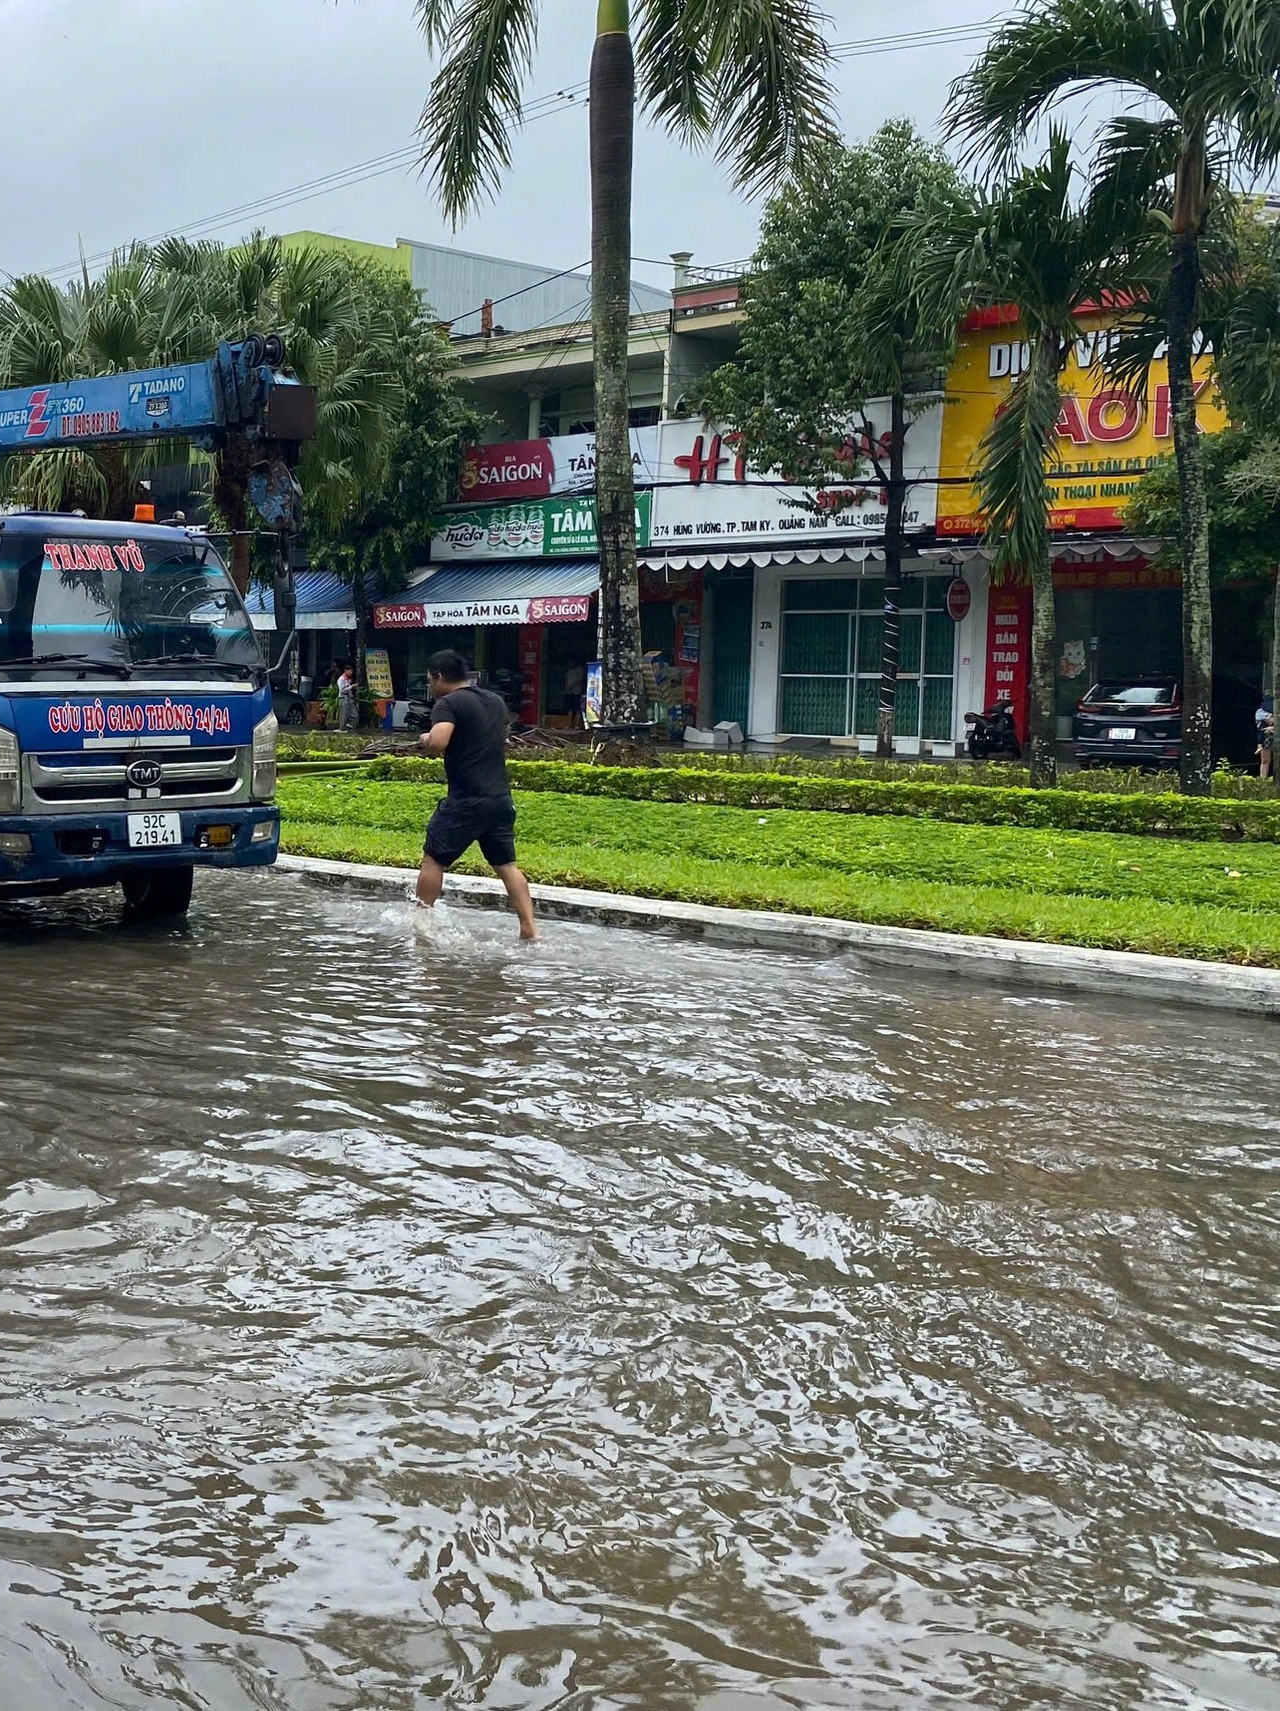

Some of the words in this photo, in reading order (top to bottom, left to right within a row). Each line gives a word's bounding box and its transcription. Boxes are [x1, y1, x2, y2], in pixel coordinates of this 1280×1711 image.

[143, 377, 185, 395] TADANO
[479, 461, 543, 484] SAIGON
[550, 508, 594, 533] TÂM
[653, 525, 669, 536] 374
[43, 543, 118, 571] THANH
[113, 539, 145, 572] VŨ
[385, 610, 421, 622] SAIGON
[466, 603, 490, 617] TÂM
[493, 604, 520, 616] NGA
[545, 603, 586, 616] SAIGON
[992, 651, 1019, 663] TRAO
[996, 688, 1011, 701] XE
[83, 698, 106, 739] HỘ
[107, 705, 145, 731] GIAO
[145, 697, 195, 731] THÔNG
[195, 704, 231, 736] 24/24
[132, 767, 159, 779] TMT
[143, 815, 166, 829] 92C
[135, 829, 176, 845] 219.41
